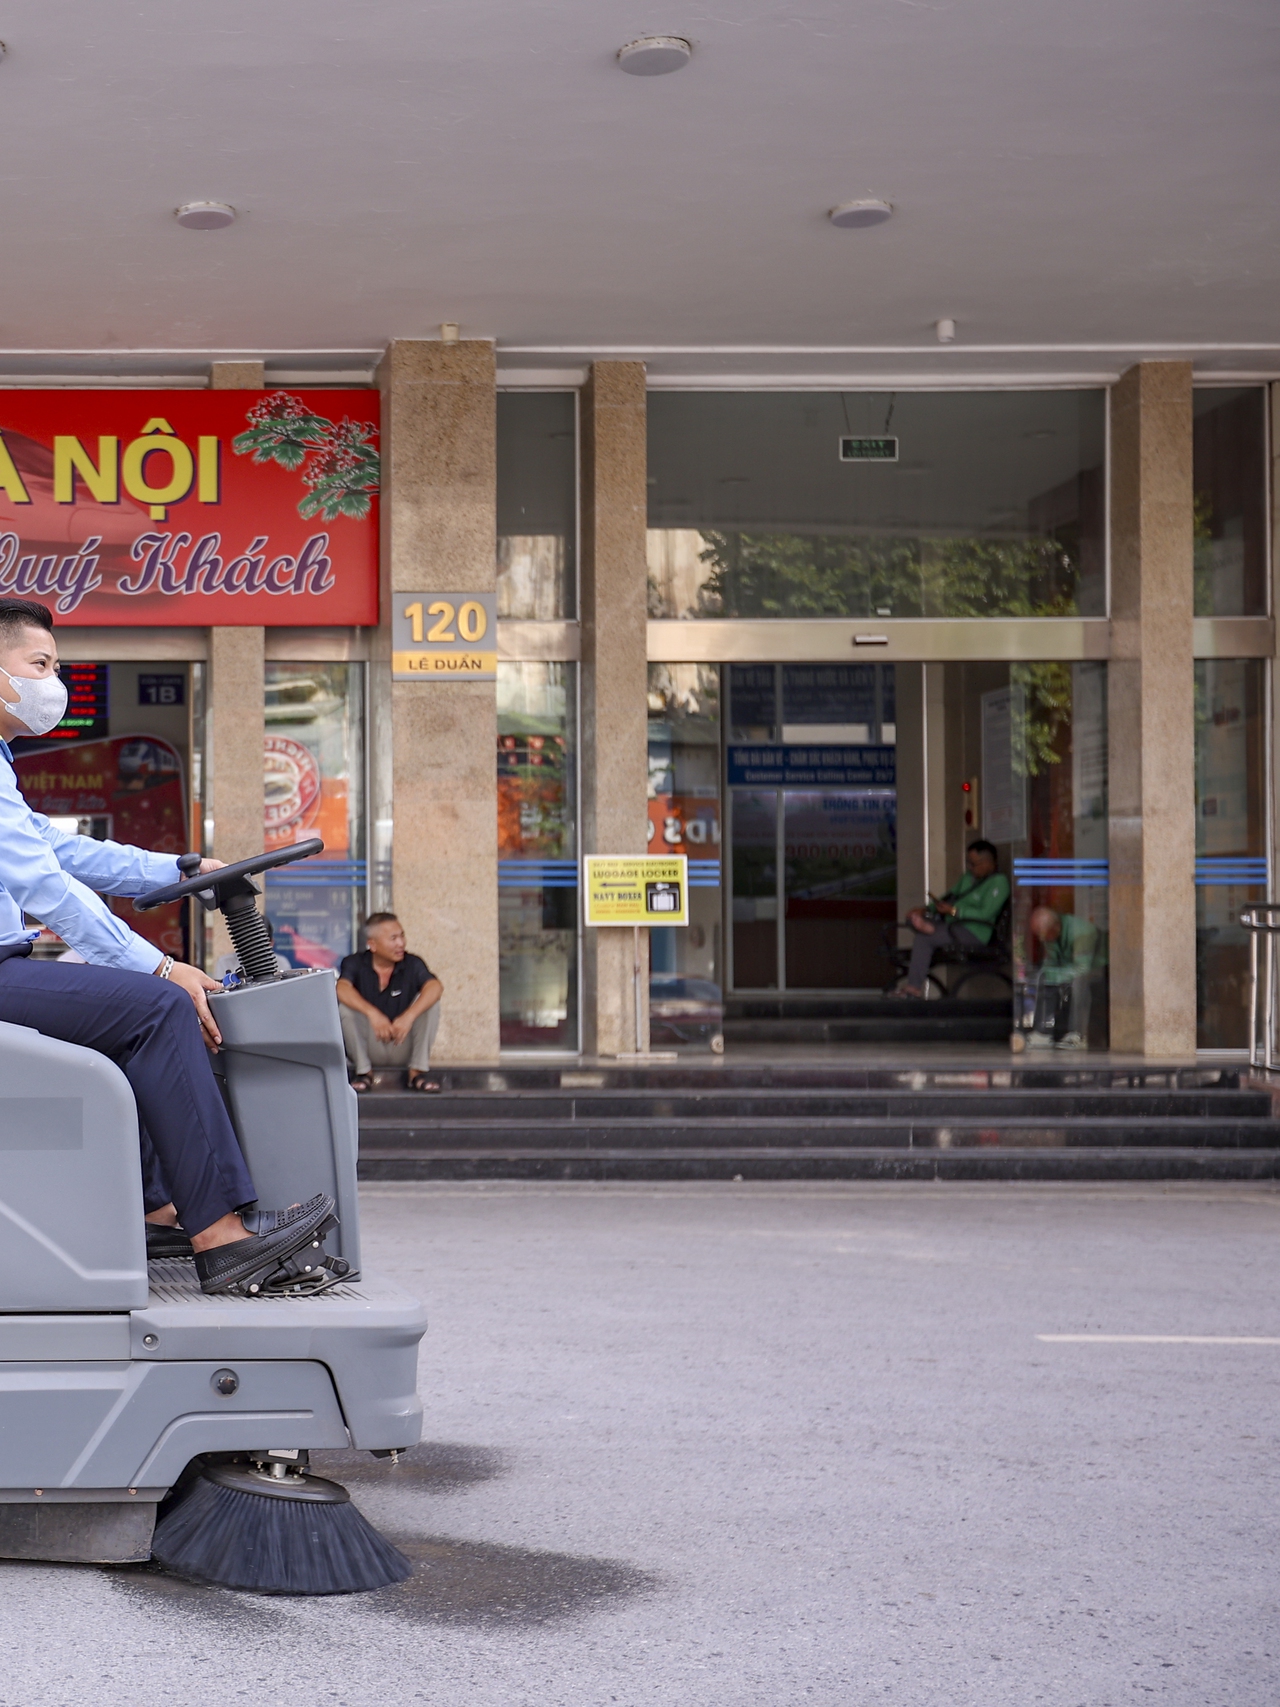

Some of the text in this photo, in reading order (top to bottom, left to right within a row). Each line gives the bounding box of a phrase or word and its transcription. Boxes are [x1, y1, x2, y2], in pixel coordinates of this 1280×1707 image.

[55, 418, 219, 520] NỘI
[117, 531, 336, 596] Khách
[404, 601, 487, 643] 120
[409, 657, 429, 670] LÊ
[147, 686, 177, 703] 1B
[21, 771, 103, 793] VIỆT NAM
[785, 844, 820, 859] 900
[593, 869, 679, 879] LUGGAGE LOCKER
